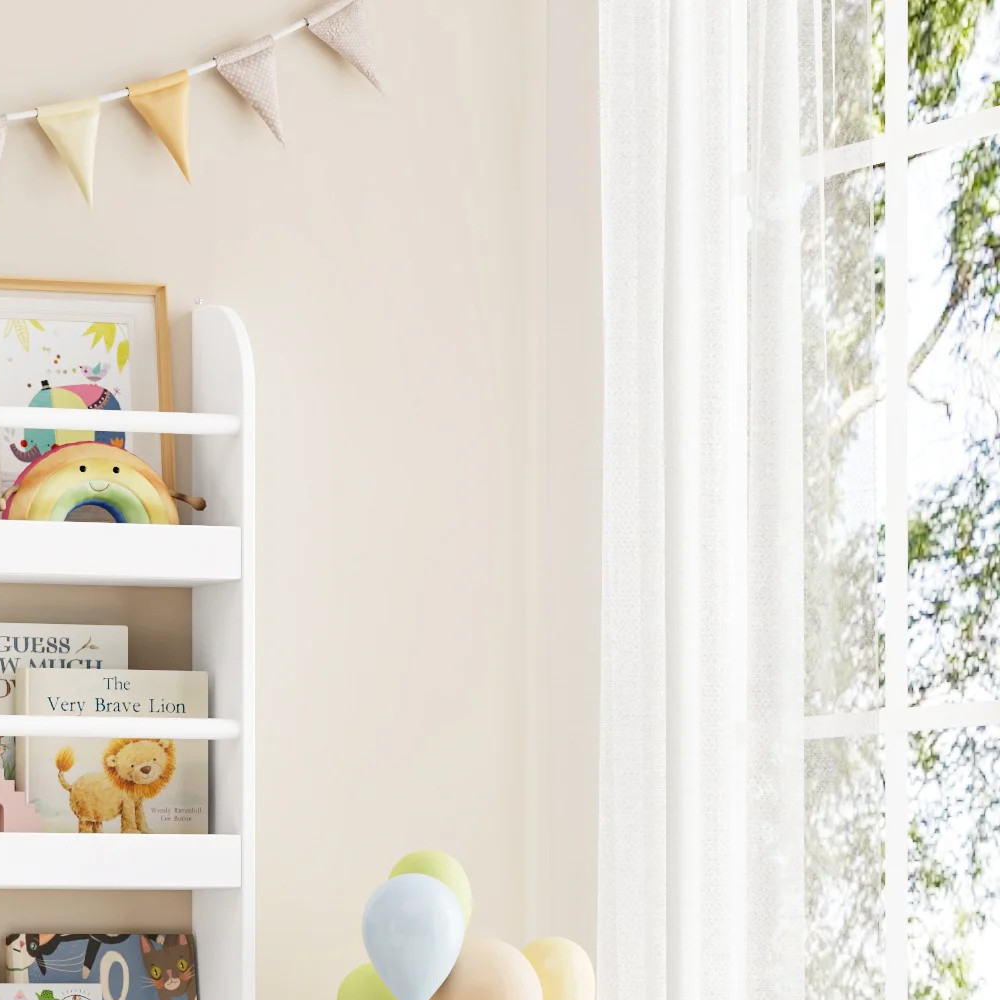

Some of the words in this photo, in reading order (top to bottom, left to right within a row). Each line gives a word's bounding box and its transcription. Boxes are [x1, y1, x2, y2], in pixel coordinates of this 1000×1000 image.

[103, 676, 131, 691] The
[47, 696, 86, 716] Very
[95, 697, 141, 713] Brave
[149, 698, 187, 714] Lion
